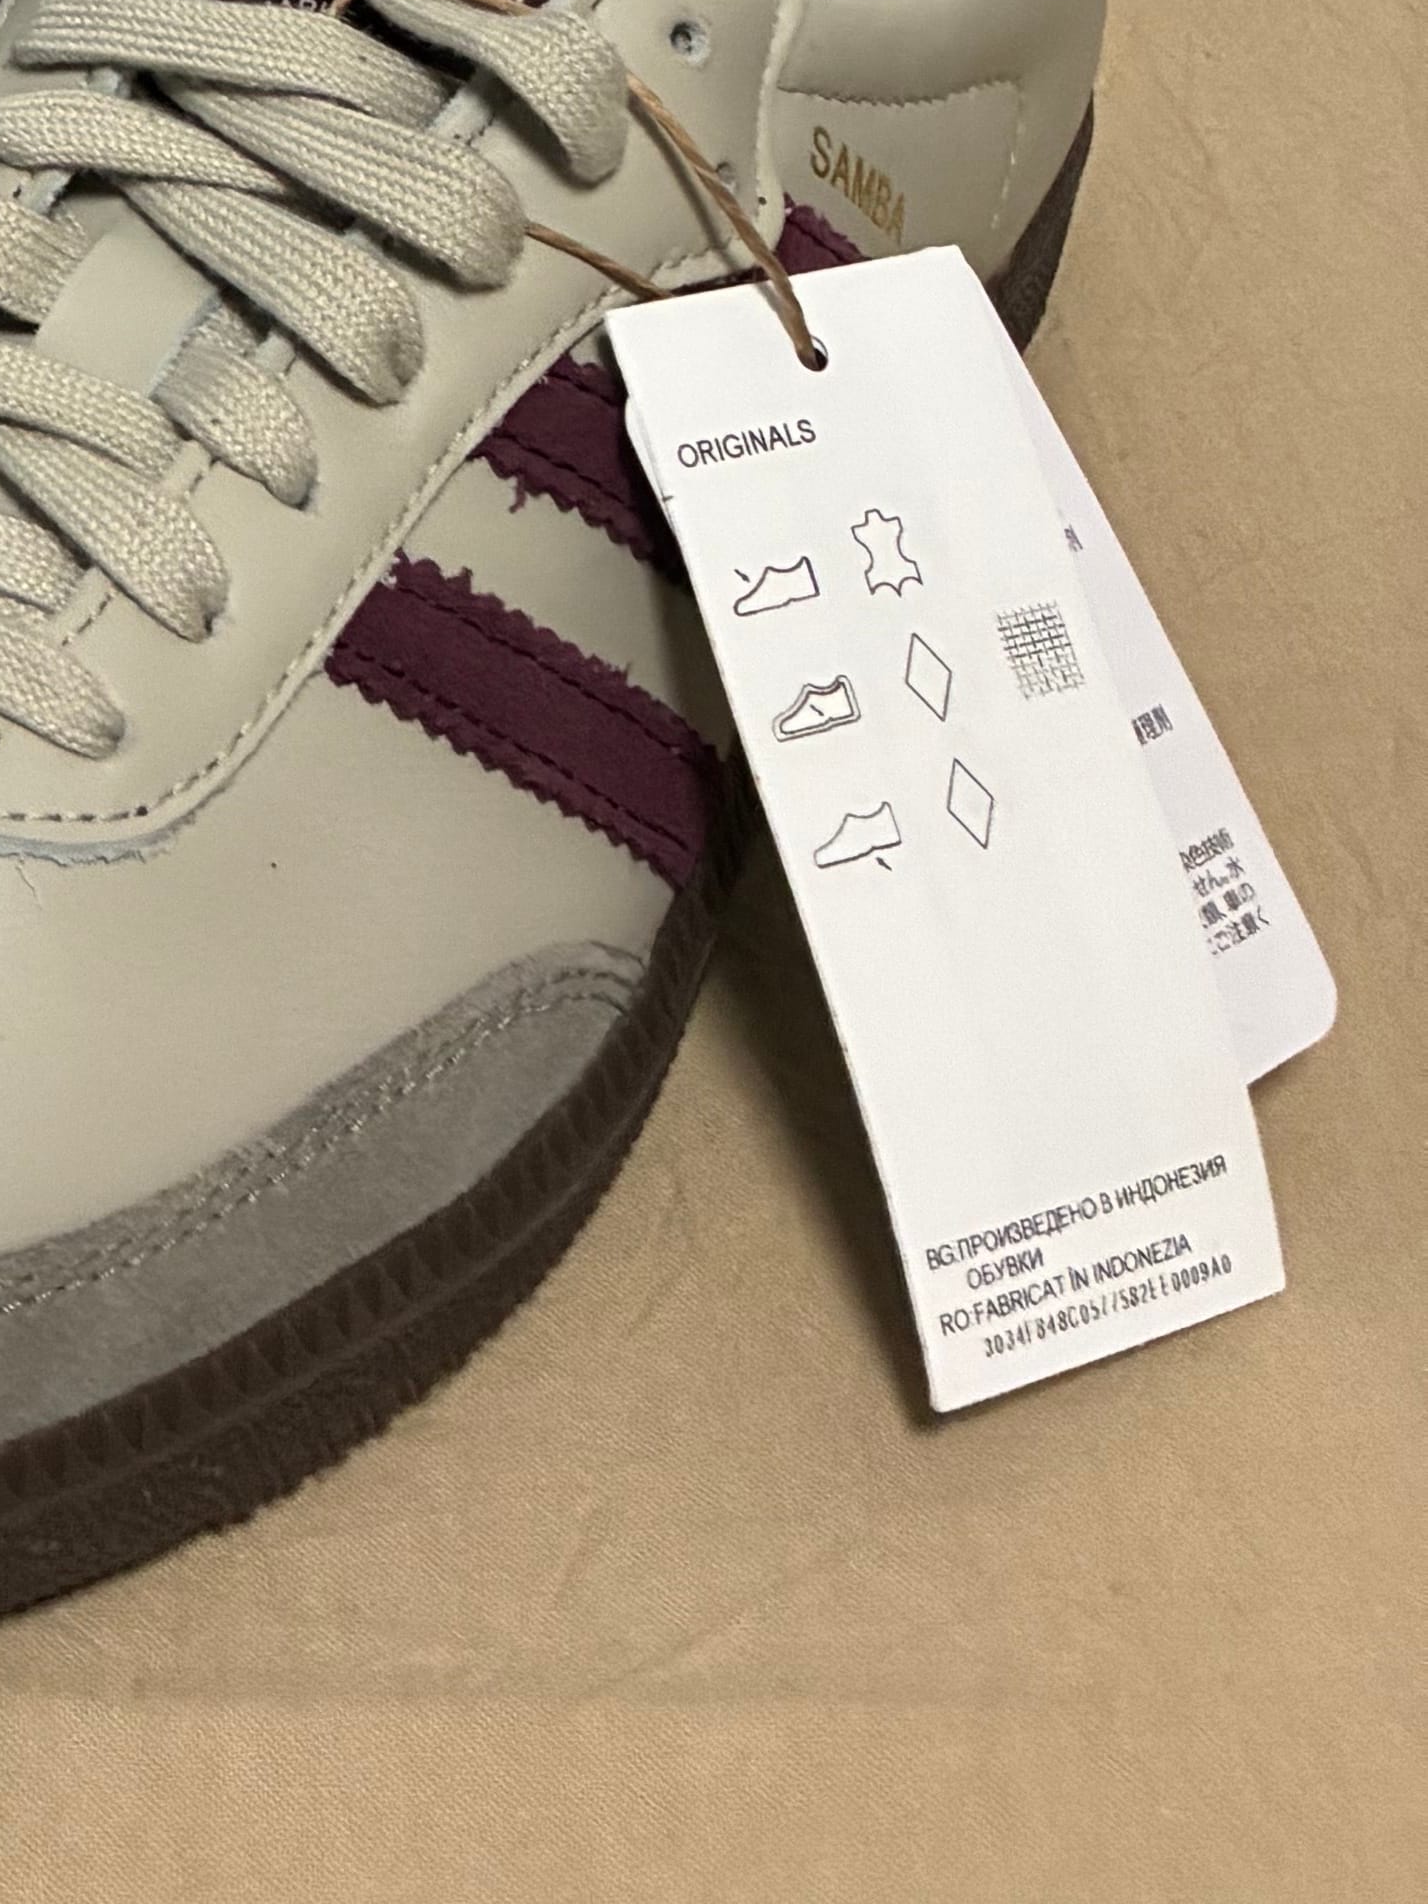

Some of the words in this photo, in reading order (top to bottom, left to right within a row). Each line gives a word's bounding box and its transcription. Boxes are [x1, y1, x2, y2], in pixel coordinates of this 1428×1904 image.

[810, 125, 906, 247] SAMBA
[677, 418, 817, 468] ORIGINALS
[1116, 1153, 1228, 1210] ИНДОНЕЗИЯ
[966, 1246, 1045, 1290] ОБУВКИ
[1092, 1232, 1193, 1285] INDONEZIA
